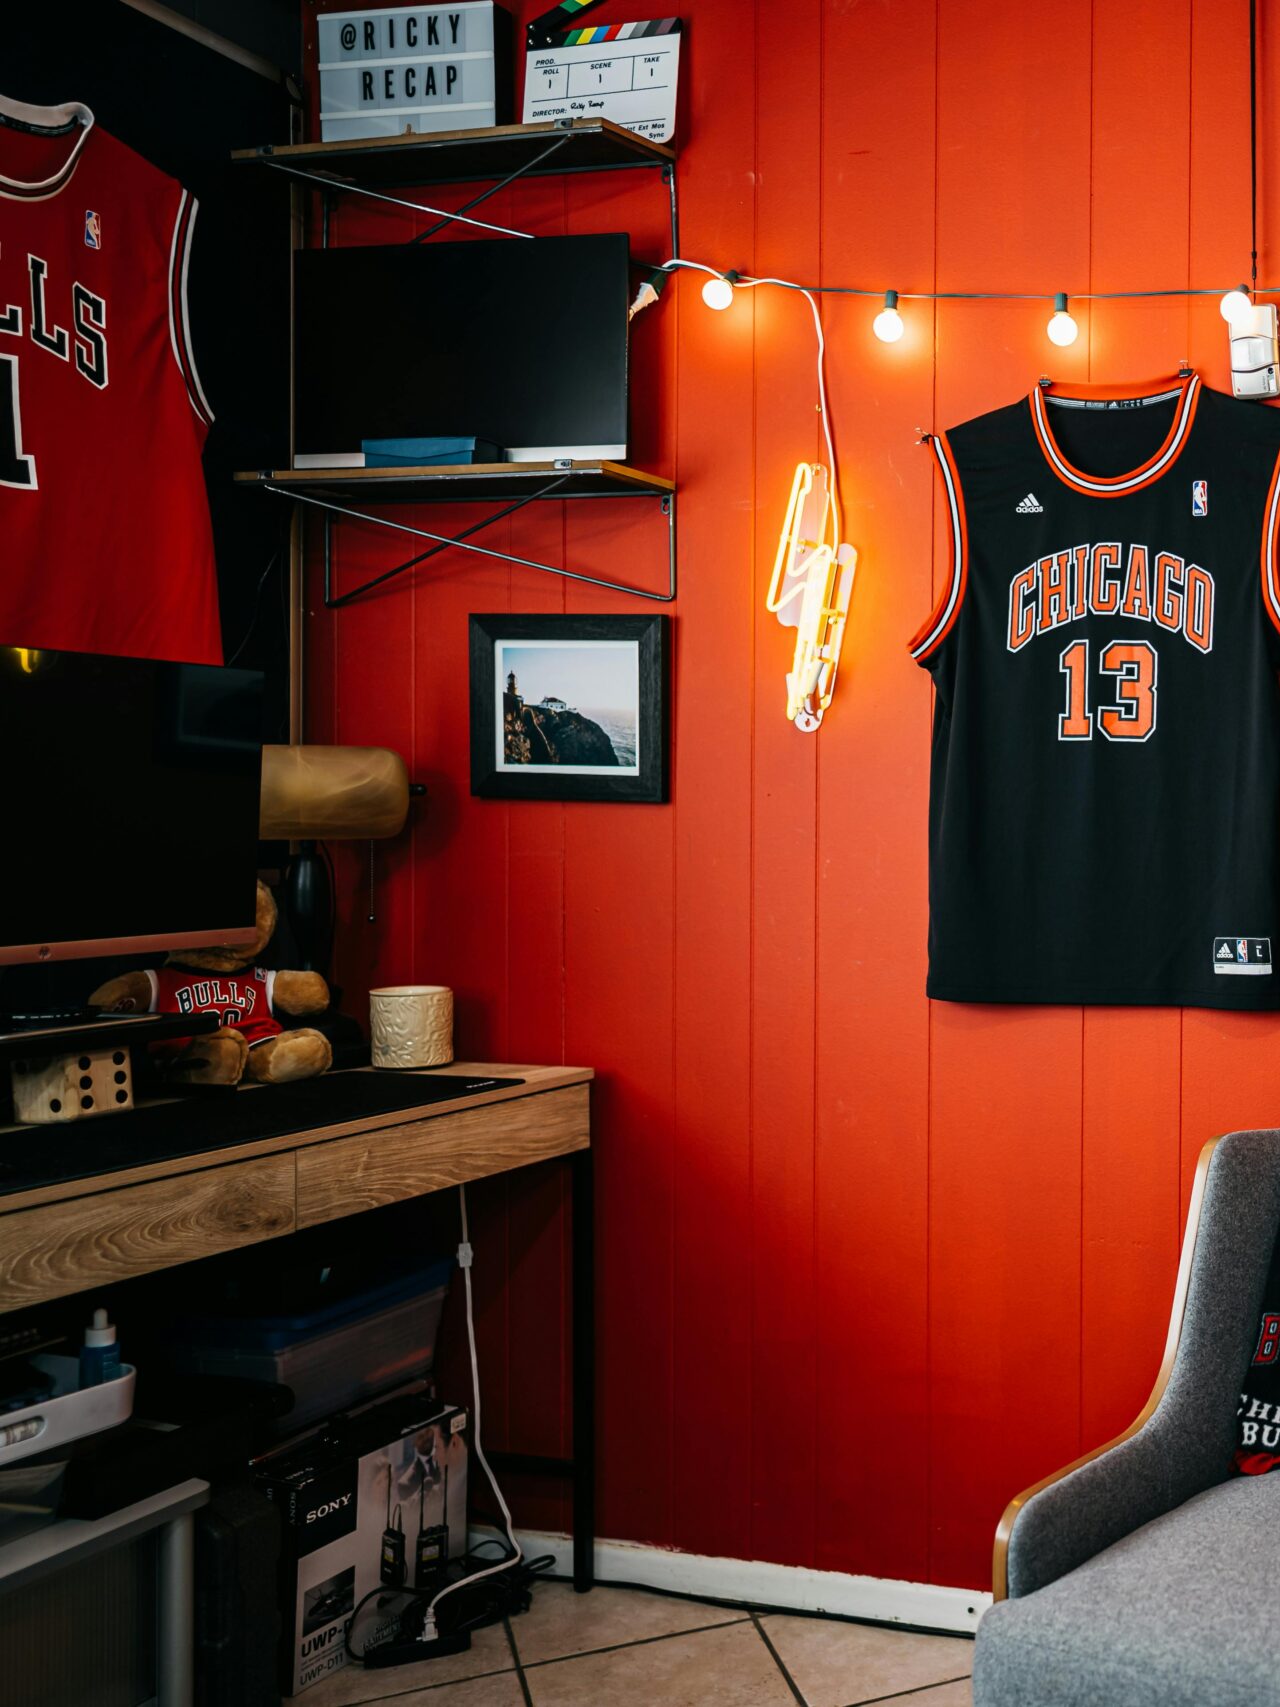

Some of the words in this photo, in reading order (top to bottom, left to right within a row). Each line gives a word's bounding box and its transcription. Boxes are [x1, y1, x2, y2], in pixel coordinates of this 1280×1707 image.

[341, 14, 460, 50] @RICKY
[590, 62, 612, 70] SCENE
[362, 65, 457, 101] RECAP
[532, 108, 567, 117] DIRECTOR:
[648, 132, 665, 140] Sync
[1016, 505, 1044, 514] adidas
[1007, 542, 1215, 654] CHICAGO
[1058, 639, 1158, 742] 13
[175, 980, 256, 1015] BULLS
[306, 1492, 352, 1524] SONY
[300, 1653, 344, 1685] UWP-D11
